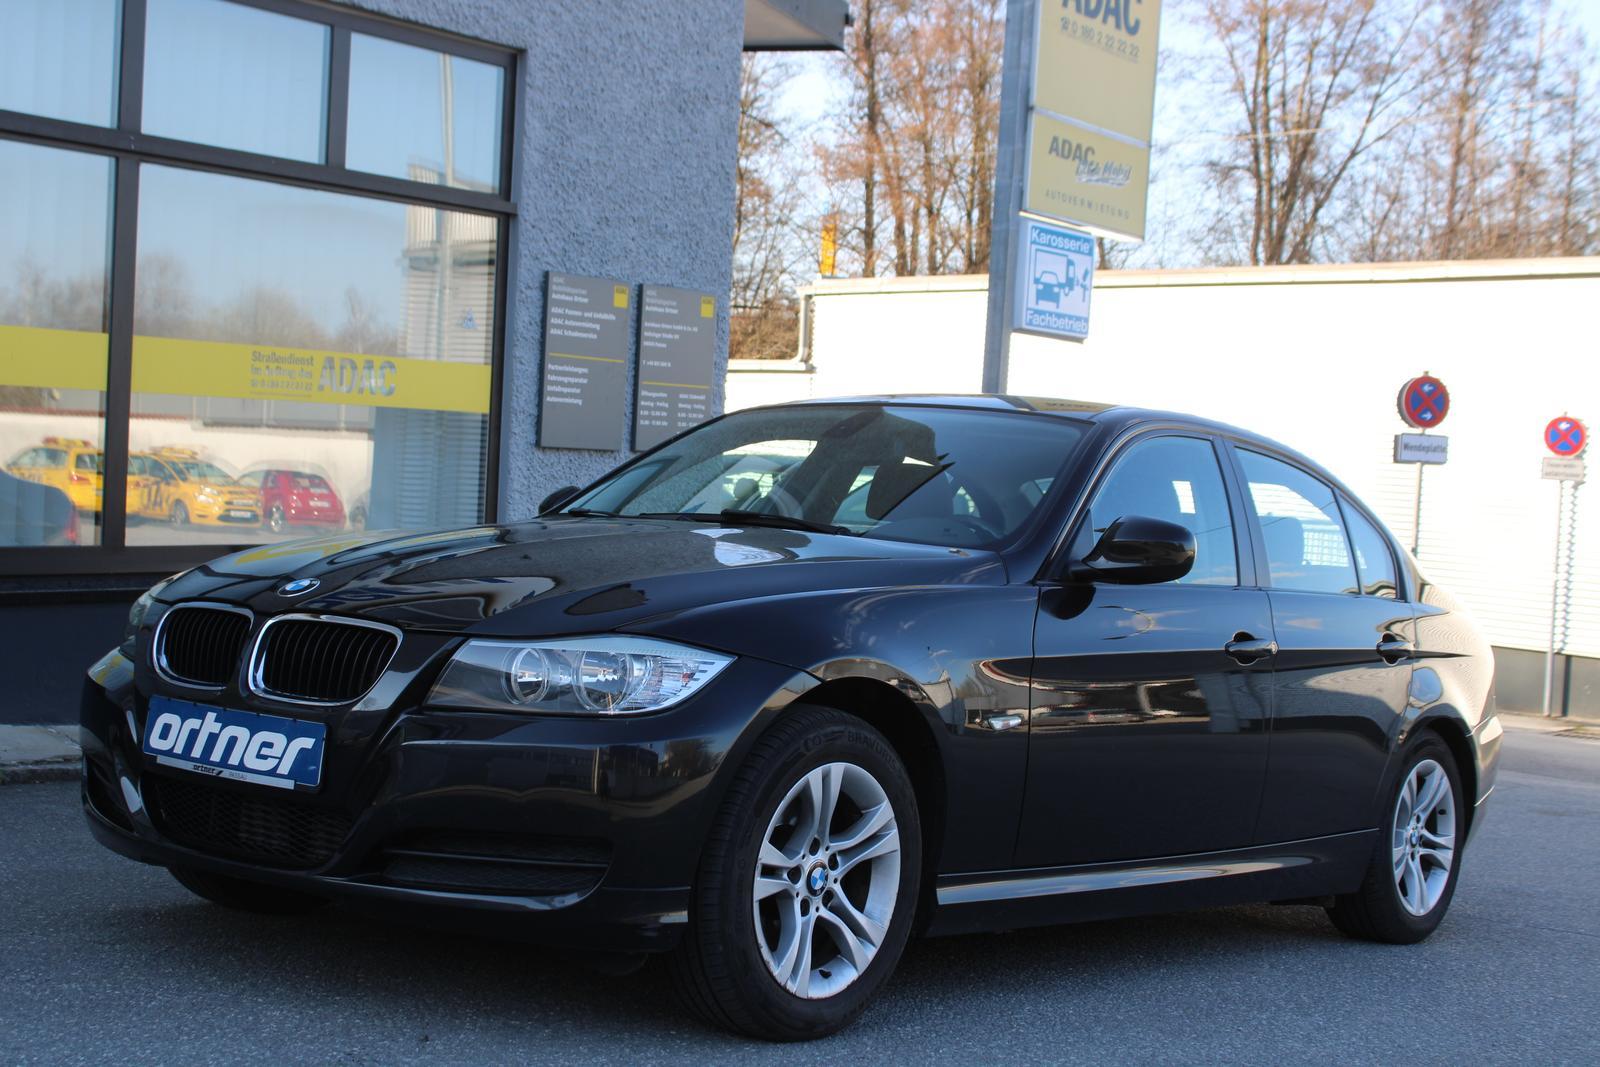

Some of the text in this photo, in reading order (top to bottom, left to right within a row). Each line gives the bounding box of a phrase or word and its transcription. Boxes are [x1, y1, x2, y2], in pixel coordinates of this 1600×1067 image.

[1048, 136, 1096, 164] ADAC
[1031, 227, 1090, 253] Karosserie
[1027, 309, 1088, 333] Fachbetrieb
[251, 350, 314, 366] Straßendienst
[317, 356, 397, 397] ADAC
[149, 711, 316, 775] ortner
[193, 763, 216, 776] ortner
